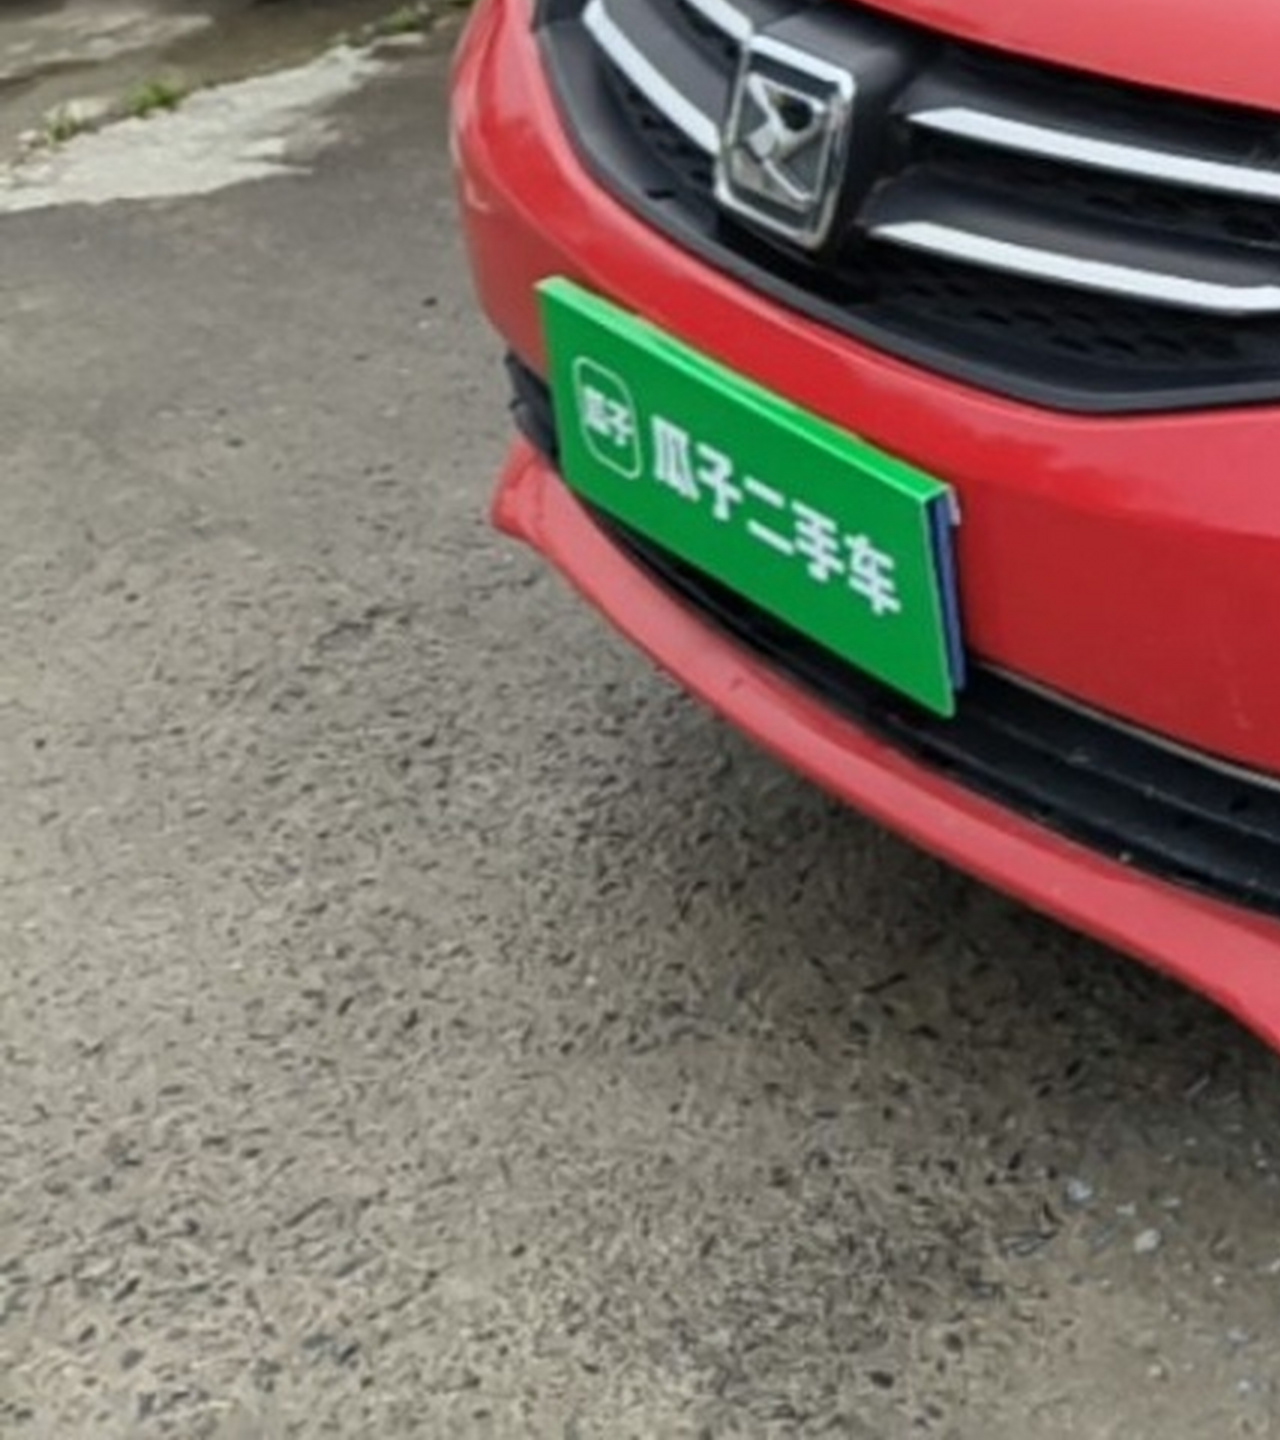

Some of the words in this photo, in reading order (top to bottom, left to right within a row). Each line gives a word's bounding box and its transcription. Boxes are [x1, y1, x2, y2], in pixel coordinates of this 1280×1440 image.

[650, 414, 901, 616] 瓜子二手车
